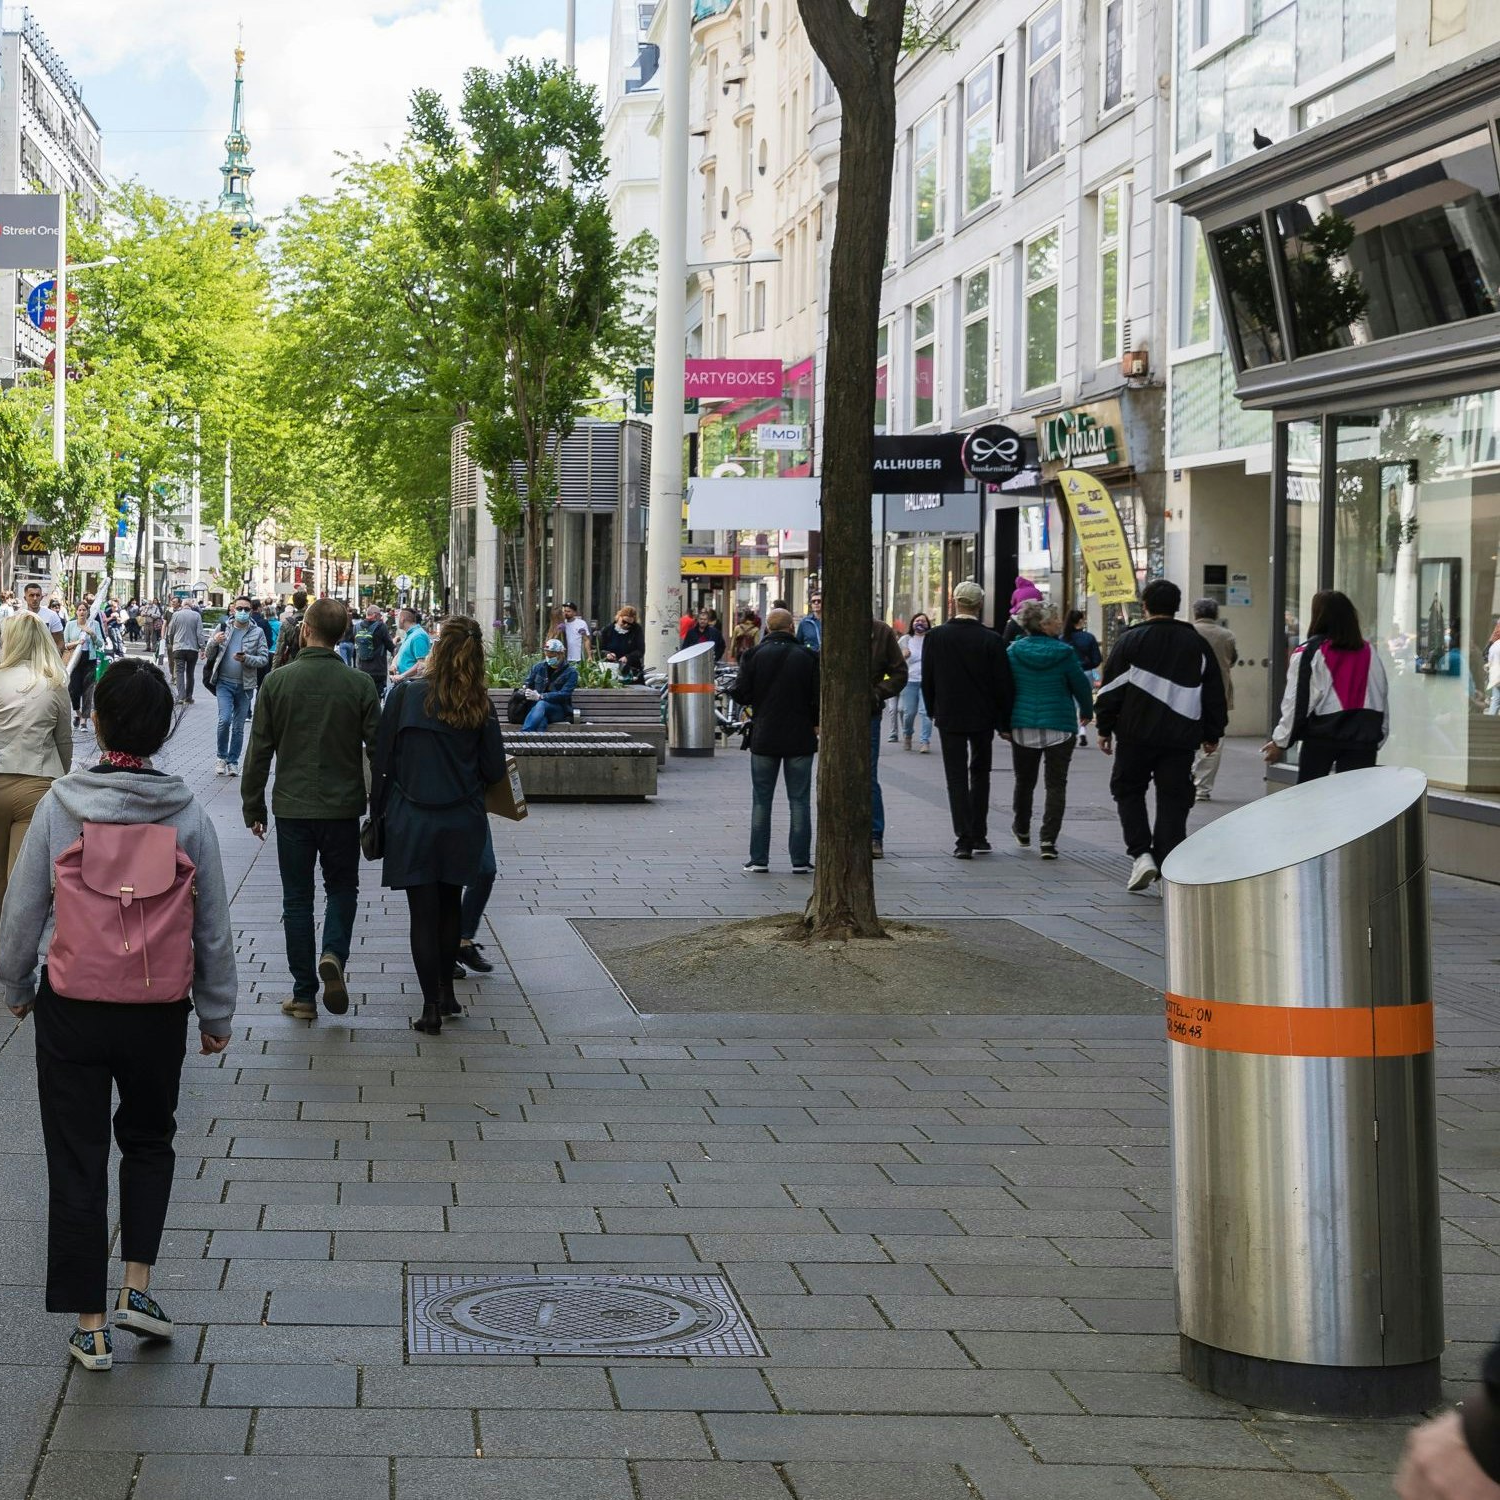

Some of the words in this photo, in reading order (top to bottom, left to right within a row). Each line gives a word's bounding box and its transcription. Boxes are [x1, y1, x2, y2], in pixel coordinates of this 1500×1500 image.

[2, 225, 36, 236] Street
[37, 225, 60, 236] One
[684, 371, 776, 386] PARTYBOXES
[772, 430, 801, 440] MDI
[1055, 411, 1108, 469] Gibian
[1092, 558, 1122, 572] VANS
[1189, 1025, 1202, 1038] 48
